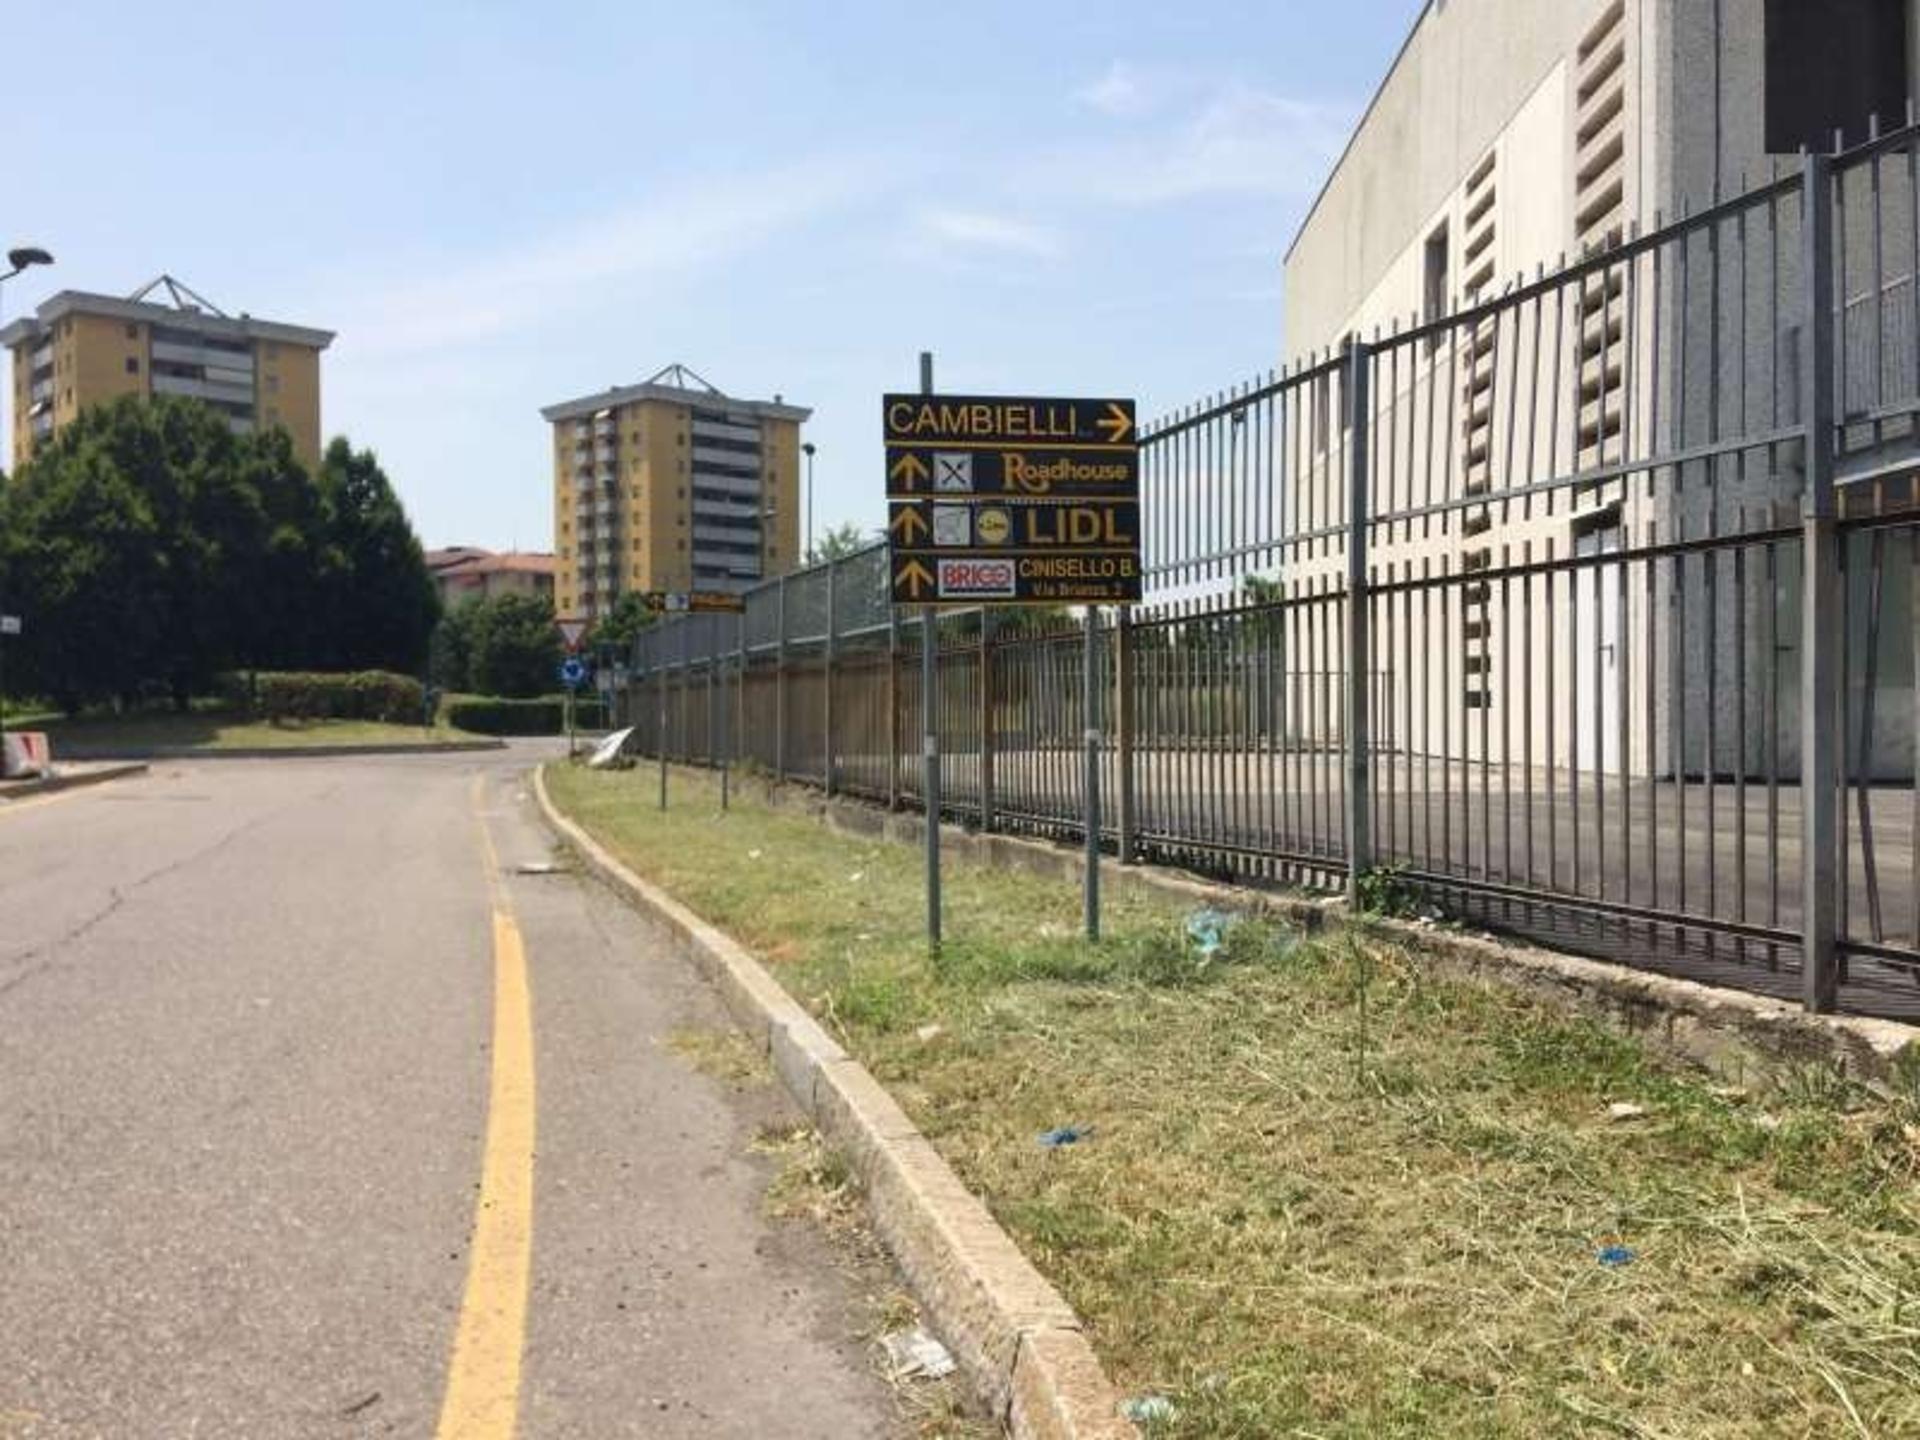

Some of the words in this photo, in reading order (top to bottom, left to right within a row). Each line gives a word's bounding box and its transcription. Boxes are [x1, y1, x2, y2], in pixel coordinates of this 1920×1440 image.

[889, 402, 1077, 436] CAMBIELLI
[1002, 453, 1129, 493] Roadhouse
[1027, 508, 1132, 545] LIDL
[1019, 558, 1114, 577] CINISELLO
